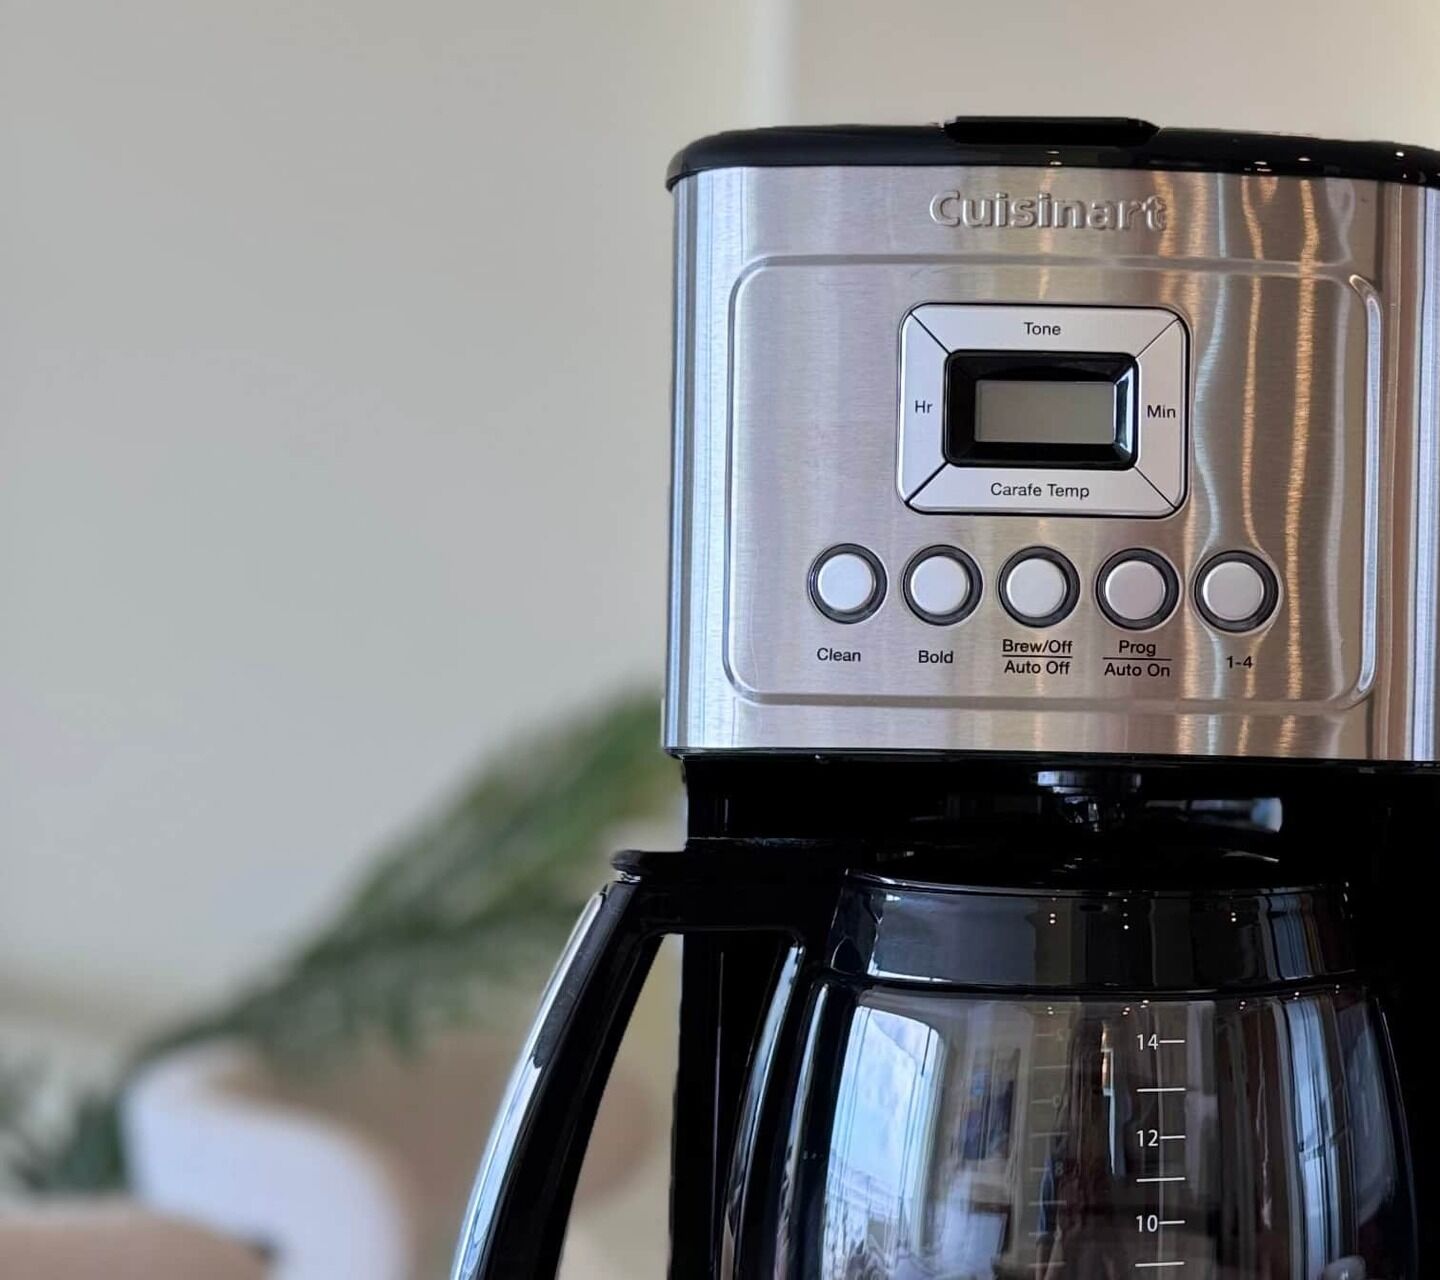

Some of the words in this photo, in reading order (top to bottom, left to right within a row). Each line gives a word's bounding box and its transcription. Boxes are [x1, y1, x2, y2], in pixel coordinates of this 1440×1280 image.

[929, 190, 1167, 231] Cuisinart
[1024, 322, 1061, 336] Tone
[914, 400, 933, 414] Hr
[1147, 405, 1176, 419] Min
[990, 483, 1042, 497] Carafe
[1047, 484, 1090, 500] Temp
[1002, 639, 1073, 654] Brew/Off
[1118, 639, 1157, 657] Prog
[816, 647, 862, 662] Clean
[918, 650, 954, 663] Bold
[1004, 661, 1041, 675] Auto
[1046, 661, 1071, 675] Off
[1104, 663, 1143, 677] Auto
[1147, 664, 1171, 677] On
[1227, 656, 1254, 669] 1-4
[1136, 1033, 1159, 1051] 14
[1136, 1129, 1159, 1148] 12
[1135, 1214, 1159, 1233] 10
